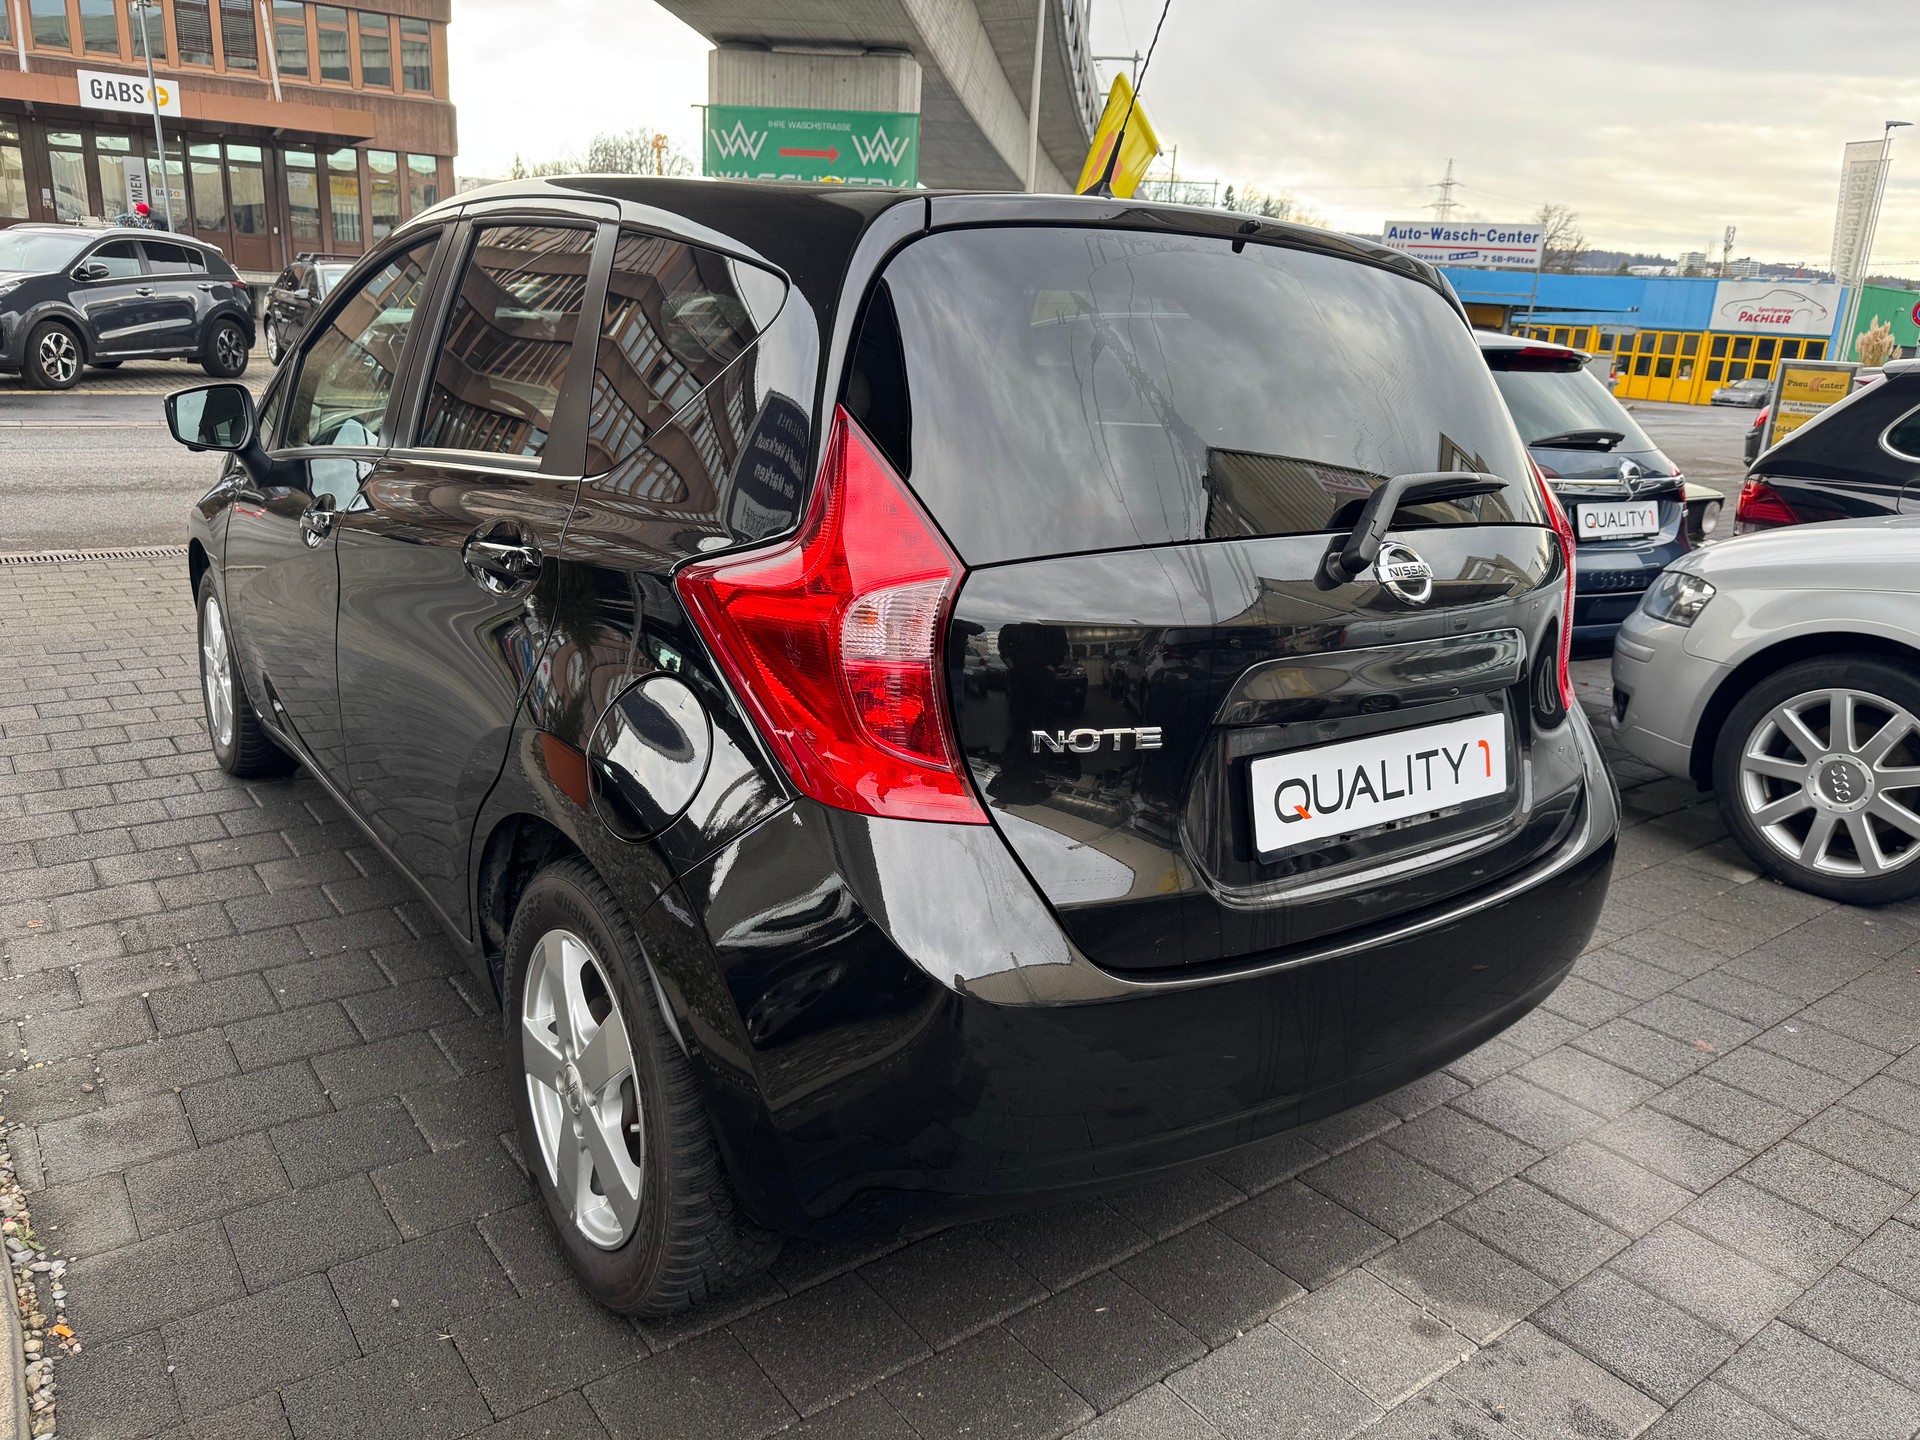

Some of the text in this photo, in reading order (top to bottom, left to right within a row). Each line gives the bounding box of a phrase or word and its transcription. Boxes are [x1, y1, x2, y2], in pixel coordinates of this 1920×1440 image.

[90, 79, 144, 104] GABS
[768, 120, 851, 132] IHRE WASCHSTRASSE
[1388, 226, 1540, 244] Auto-Wasch-Center
[1738, 311, 1792, 324] PACHLER
[1758, 306, 1794, 314] Sportgarage
[1585, 510, 1647, 529] QUALITY
[1388, 565, 1431, 577] NISSAN
[1031, 727, 1163, 753] NOTE
[1274, 739, 1491, 824] QUALITY 1
